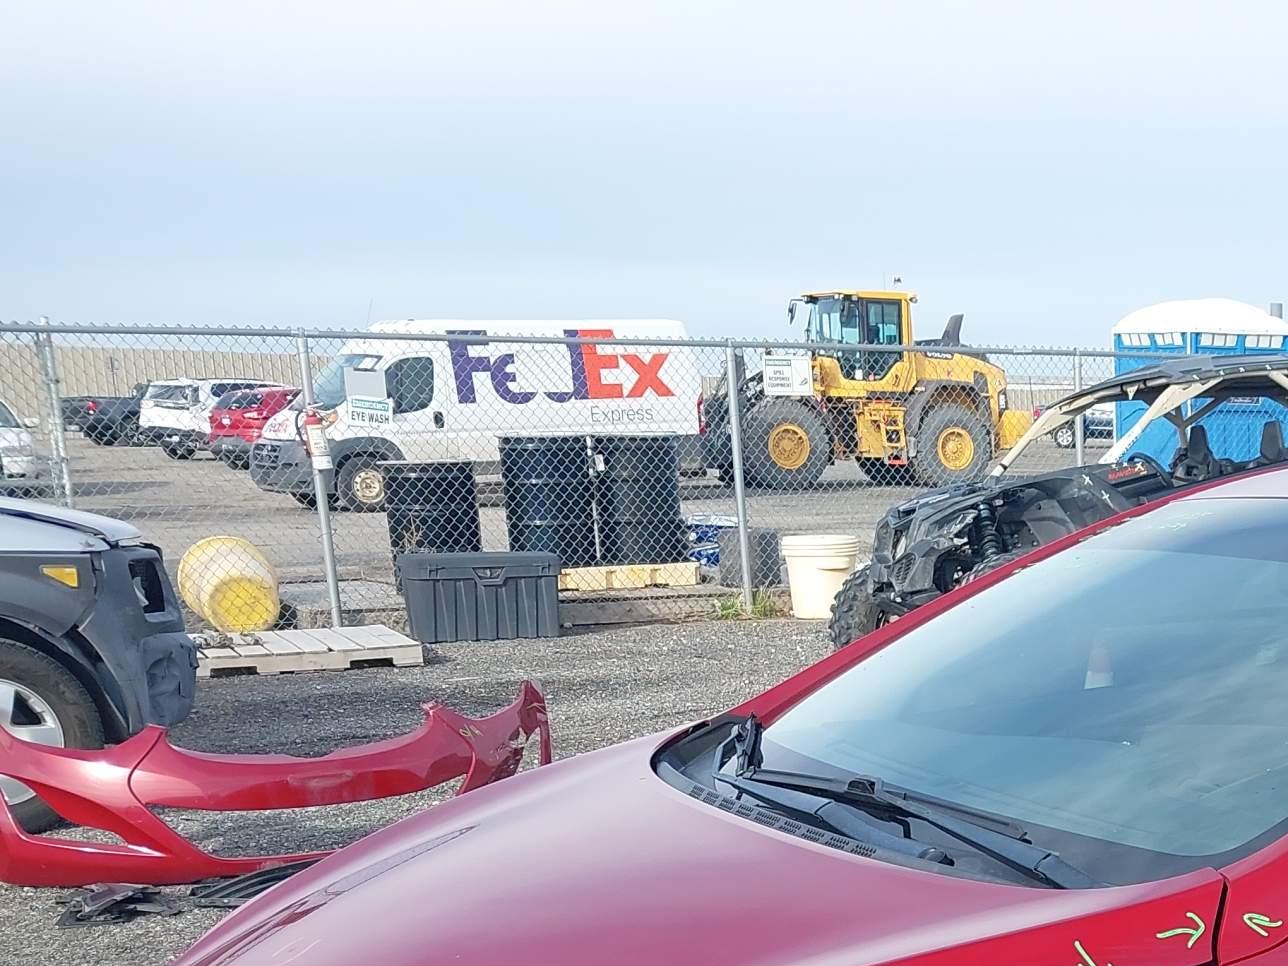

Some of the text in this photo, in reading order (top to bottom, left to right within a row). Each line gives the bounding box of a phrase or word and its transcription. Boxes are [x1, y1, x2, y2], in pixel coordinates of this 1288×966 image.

[445, 329, 676, 405] FedEx
[351, 411, 390, 424] EYE WASH
[590, 405, 654, 424] Express
